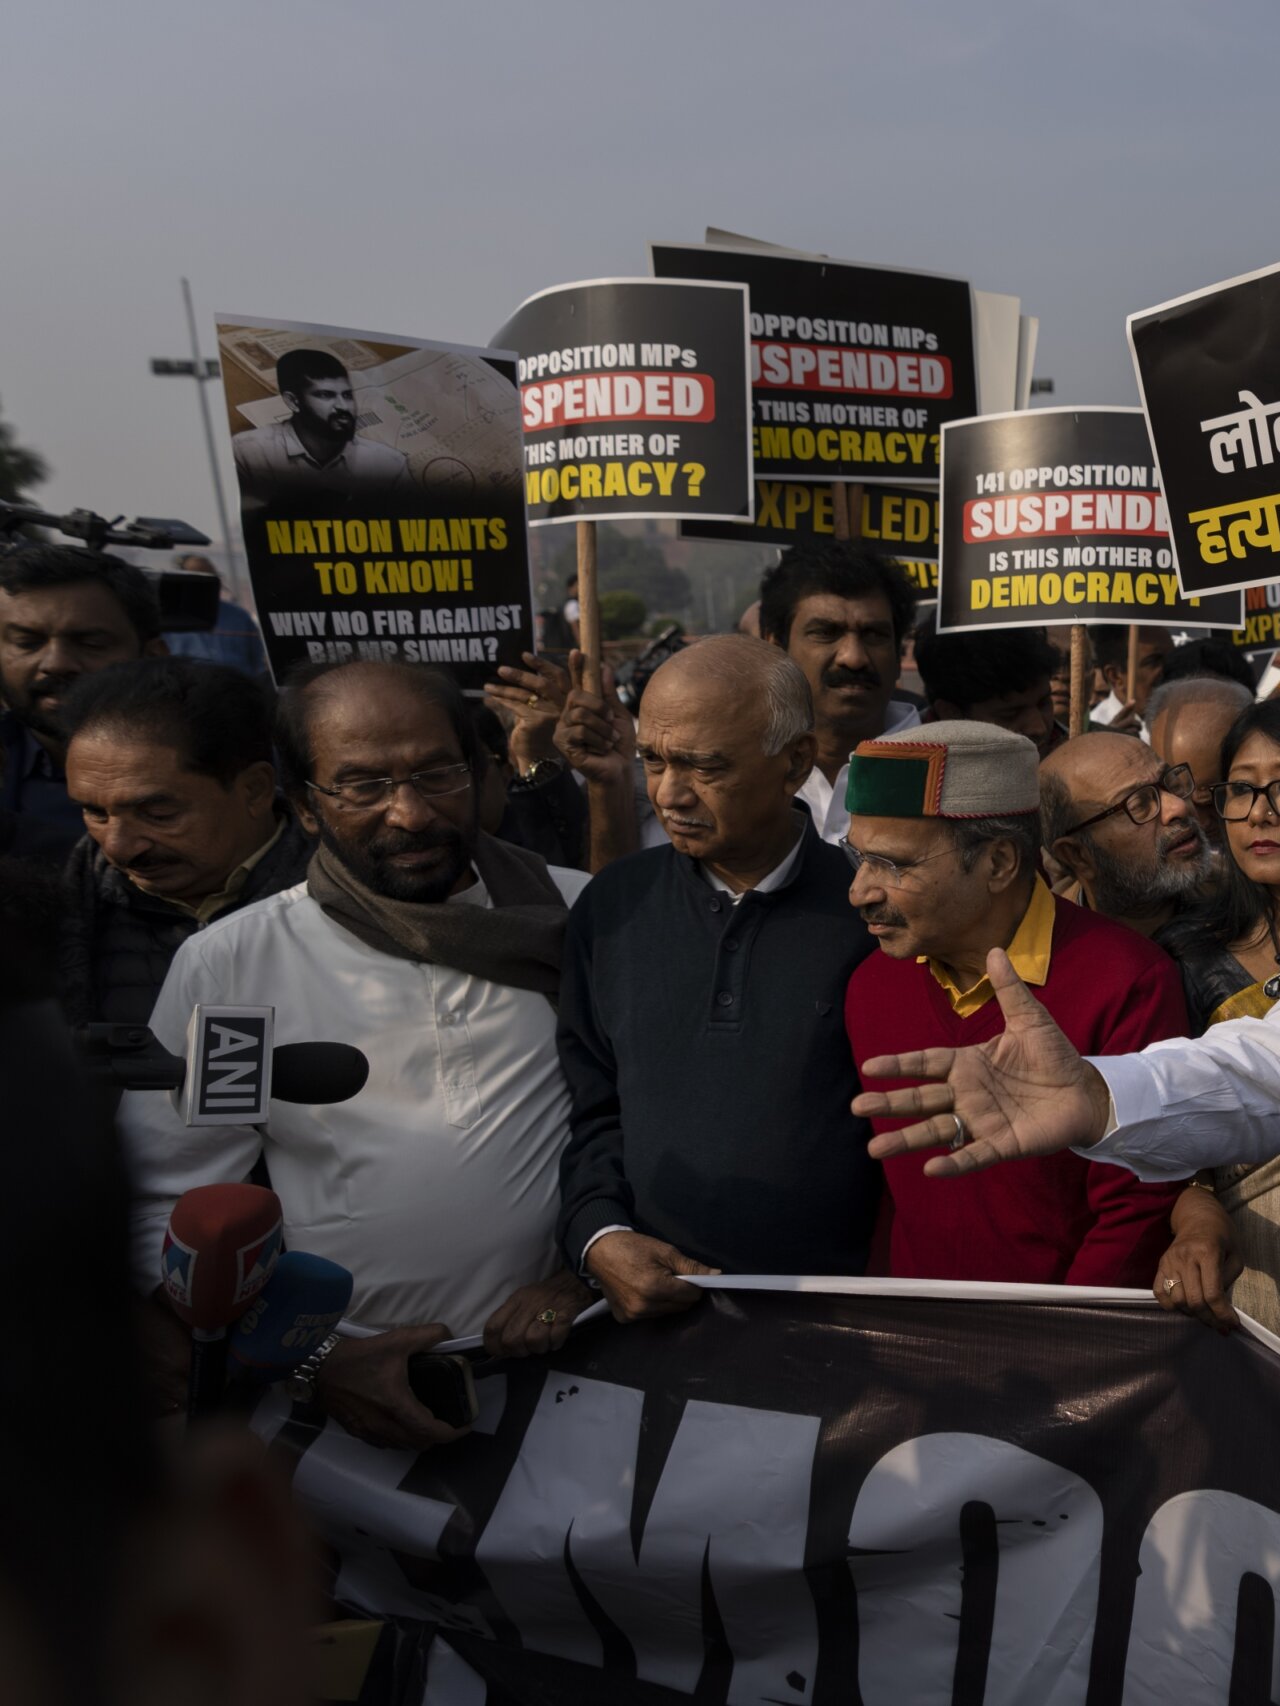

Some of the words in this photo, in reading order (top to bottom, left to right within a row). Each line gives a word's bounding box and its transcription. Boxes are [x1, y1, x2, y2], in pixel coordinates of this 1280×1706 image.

[750, 311, 887, 347] OPPOSITION
[892, 325, 939, 351] MPs
[518, 344, 635, 382] OPPOSITION
[641, 343, 698, 368] MPs
[522, 375, 705, 427] SPENDED
[758, 400, 810, 423] THIS
[813, 403, 899, 428] MOTHER
[902, 408, 928, 429] OF
[559, 434, 644, 460] MOTHER
[648, 434, 680, 456] OF
[976, 472, 1004, 495] 141
[1009, 464, 1148, 491] OPPOSITION
[265, 519, 394, 555] NATION
[399, 517, 508, 553] WANTS
[314, 561, 357, 595] TO
[363, 559, 474, 594] KNOW!
[989, 552, 1008, 572] IS
[1012, 549, 1059, 571] THIS
[1063, 547, 1152, 569] MOTHER
[1156, 548, 1177, 569] O
[970, 571, 1200, 610] DEMOCRACY
[268, 611, 326, 636] WHY
[331, 610, 369, 636] NO
[372, 609, 415, 635] FIR
[419, 605, 522, 634] AGAINST
[403, 637, 499, 663] SIMHA?
[205, 1023, 259, 1107] ANI
